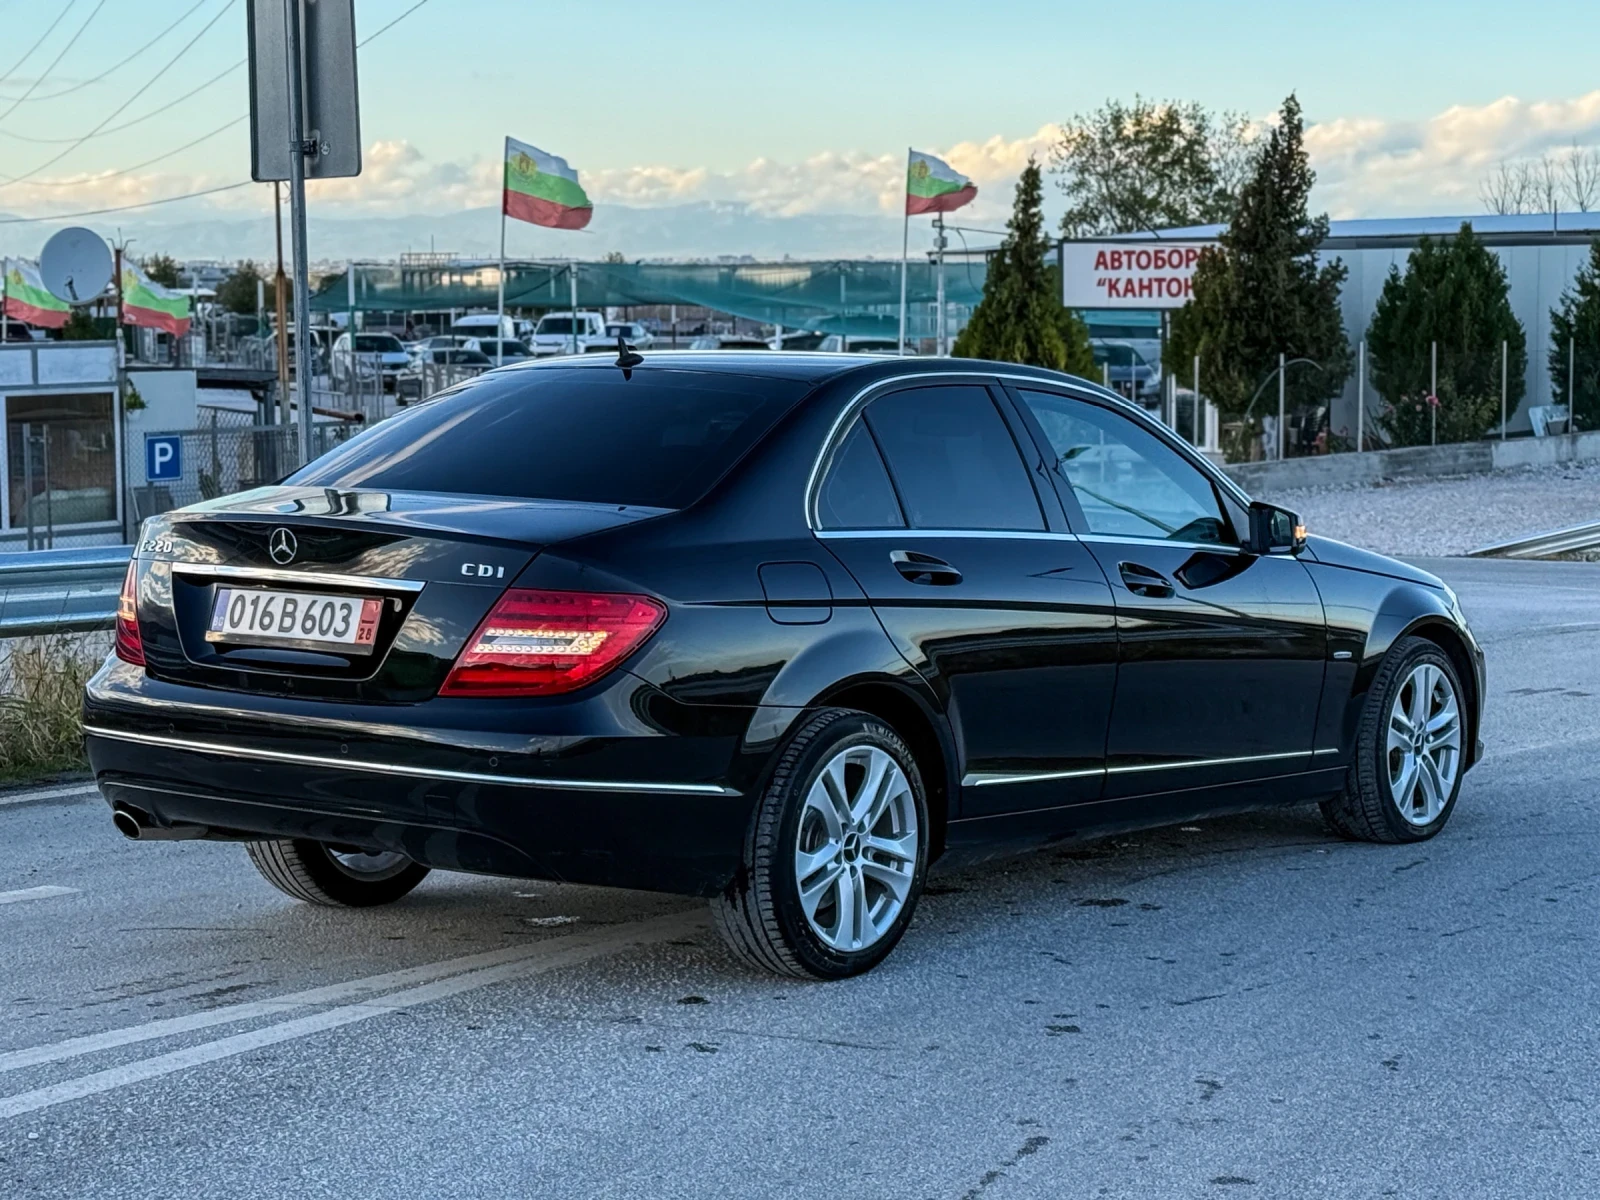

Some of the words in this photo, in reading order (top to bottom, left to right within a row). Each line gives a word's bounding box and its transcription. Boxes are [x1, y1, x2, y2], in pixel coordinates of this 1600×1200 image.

[1094, 248, 1201, 271] АВТОБОР
[154, 442, 173, 475] P
[461, 563, 505, 579] CDI
[229, 594, 353, 638] 016B603
[358, 628, 372, 641] 28
